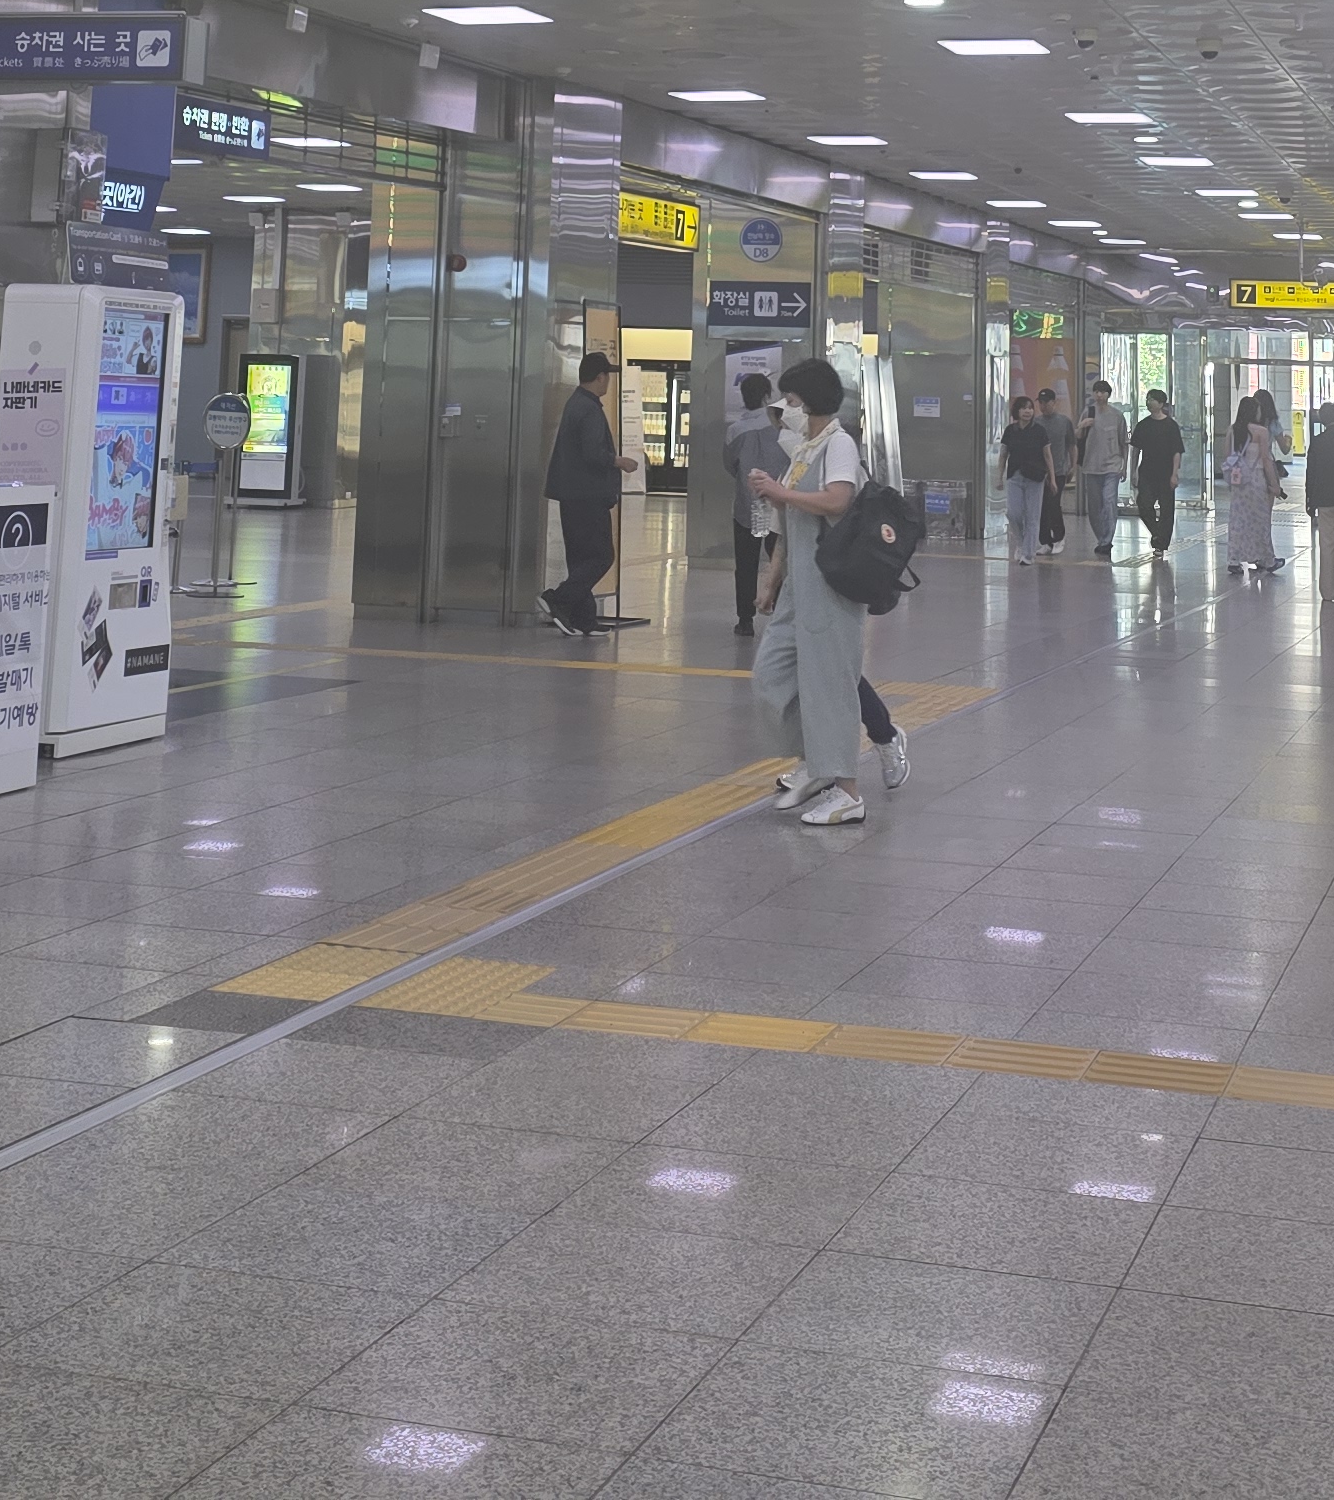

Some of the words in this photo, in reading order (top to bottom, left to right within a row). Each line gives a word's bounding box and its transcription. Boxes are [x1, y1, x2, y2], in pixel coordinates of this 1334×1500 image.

[14, 31, 65, 52] 승차권
[72, 31, 106, 52] 사는
[114, 31, 131, 52] 곳
[182, 105, 210, 129] 승차권
[677, 212, 684, 238] 7
[753, 247, 769, 259] D8
[712, 290, 750, 306] 화장실
[1240, 286, 1253, 302] 7
[723, 307, 750, 317] Toilet
[3, 380, 63, 395] 나마네카드
[2, 396, 38, 410] 자판기
[126, 652, 165, 669] #NAMANE
